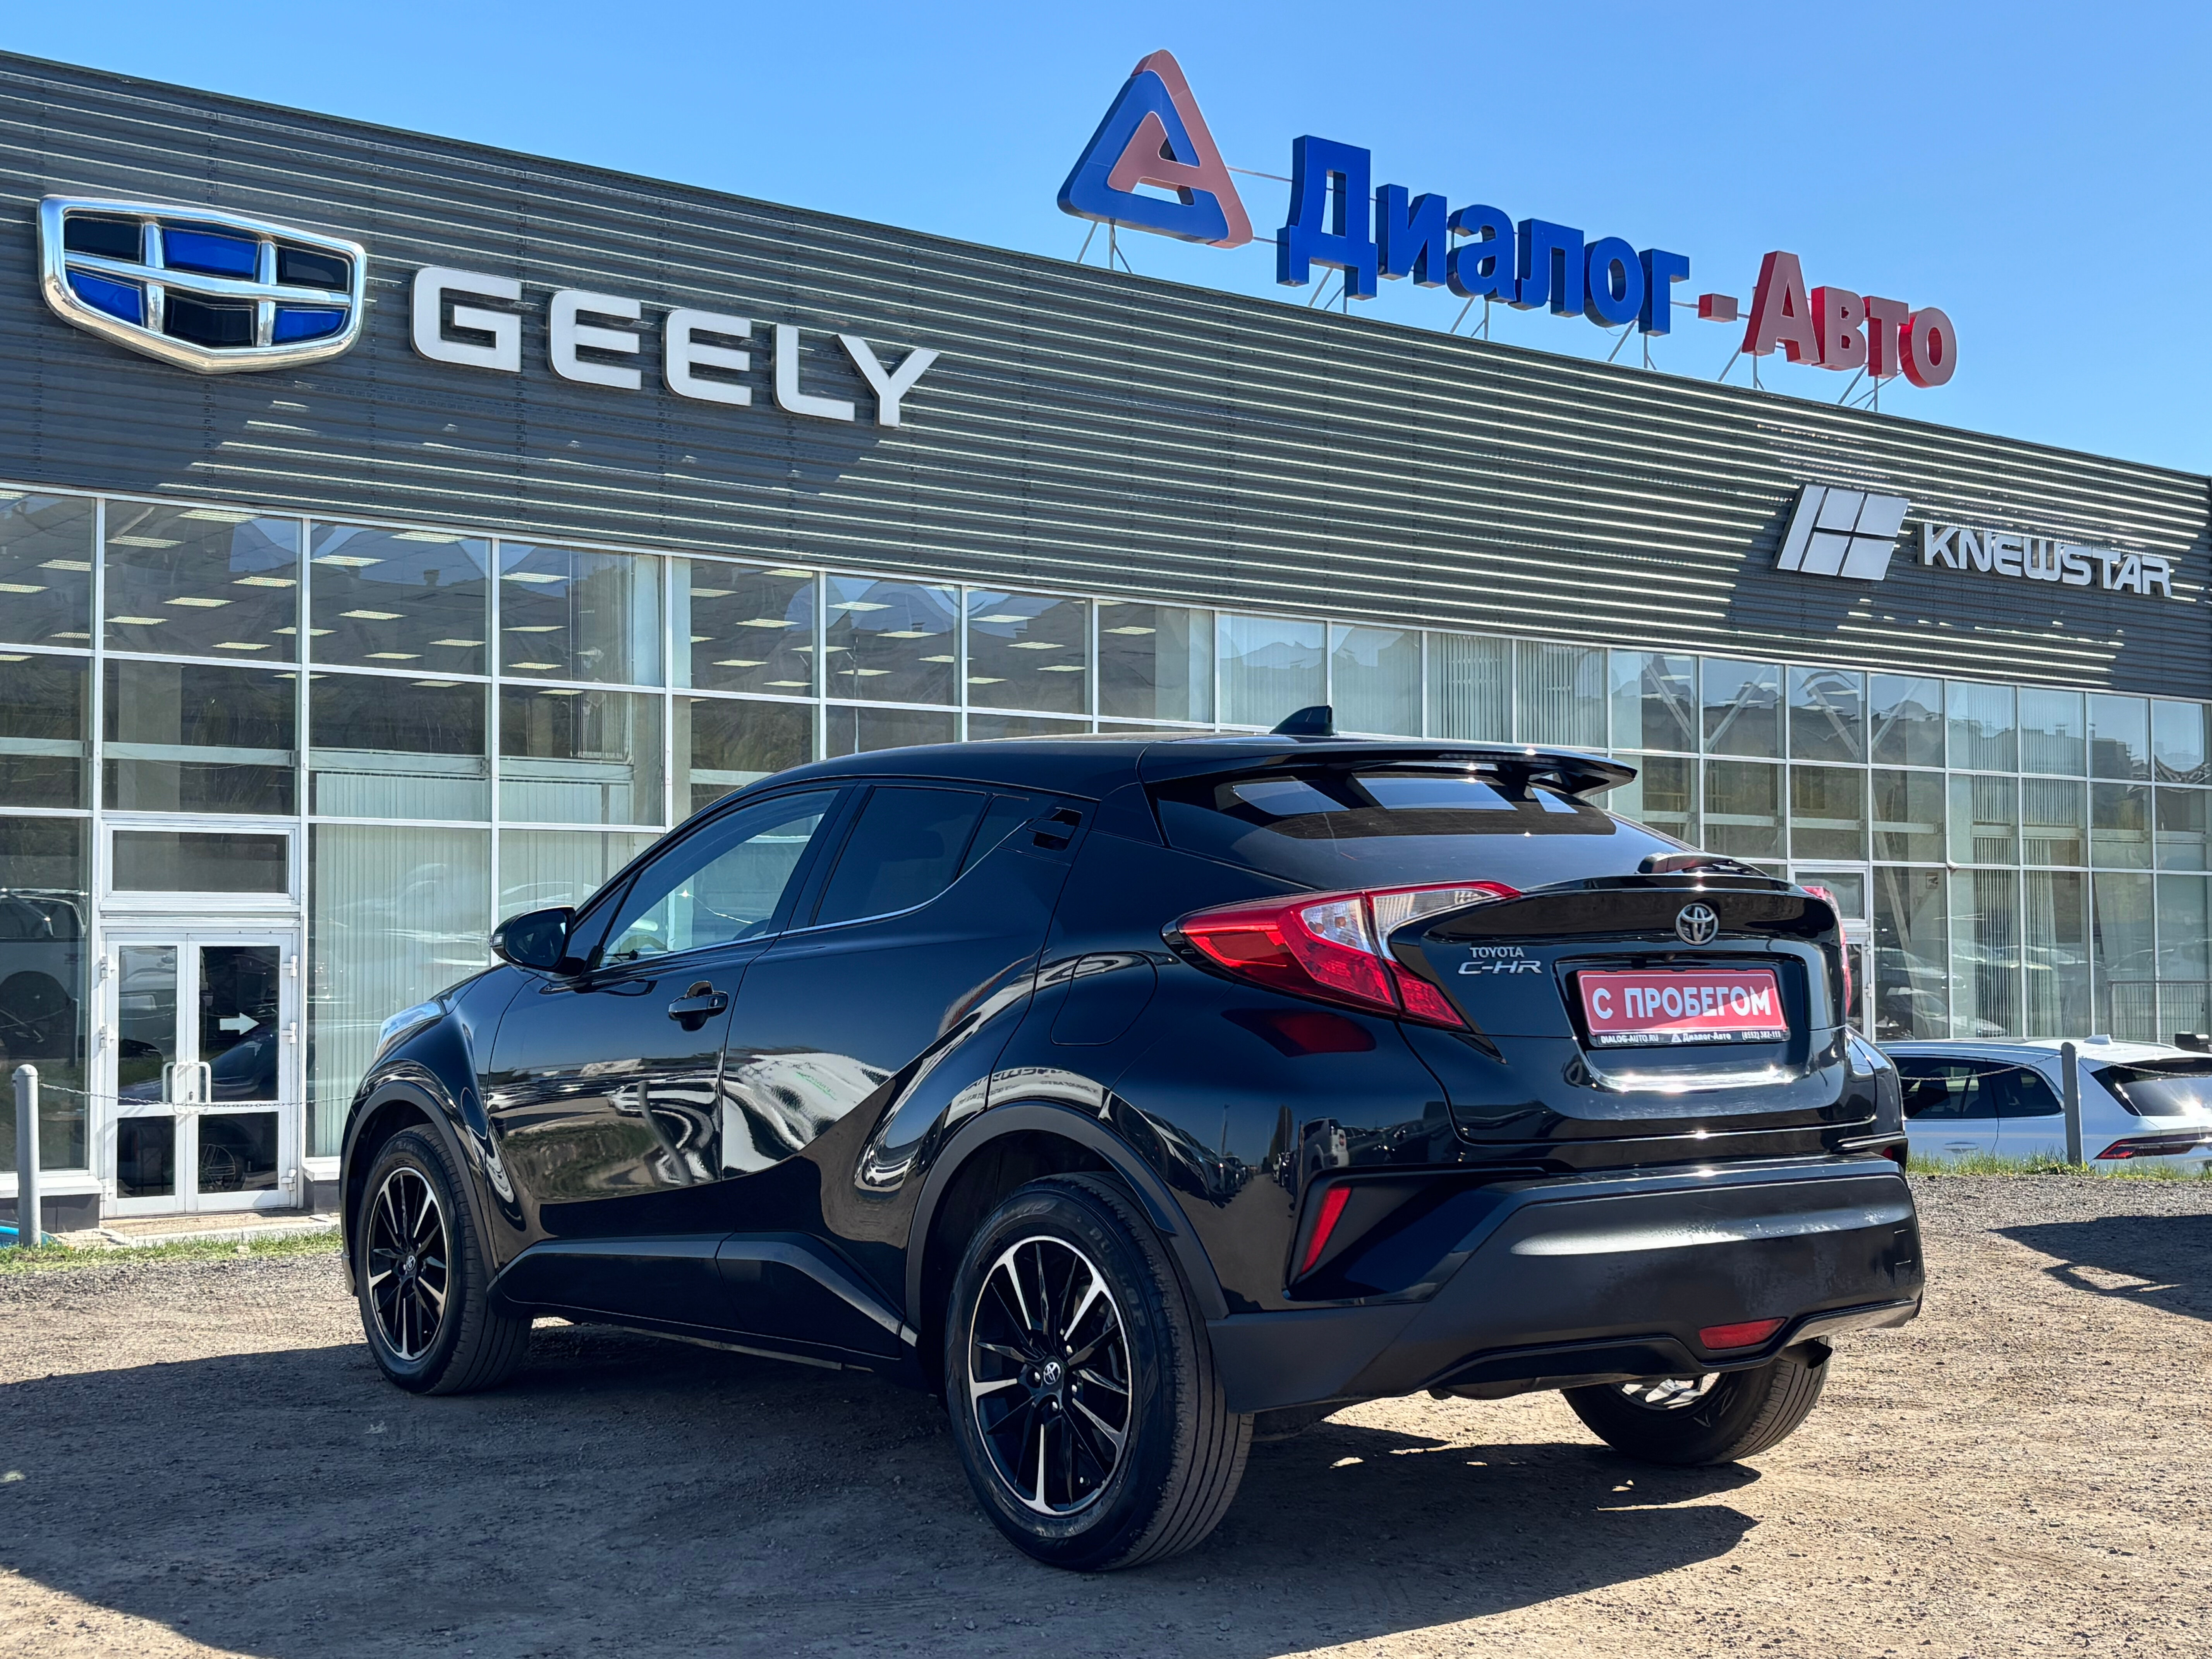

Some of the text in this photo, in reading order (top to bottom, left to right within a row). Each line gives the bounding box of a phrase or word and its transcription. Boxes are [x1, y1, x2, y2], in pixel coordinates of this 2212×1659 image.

[1277, 135, 1957, 388] Диалог-Авто
[410, 266, 940, 428] GEELY
[1919, 523, 2171, 597] KNEWSTAR
[1458, 960, 1542, 974] C-HR
[1469, 946, 1525, 958] TOYOTA
[1592, 986, 1771, 1019] С ПРОБЕГОМ
[1089, 1225, 1146, 1327] DULOP
